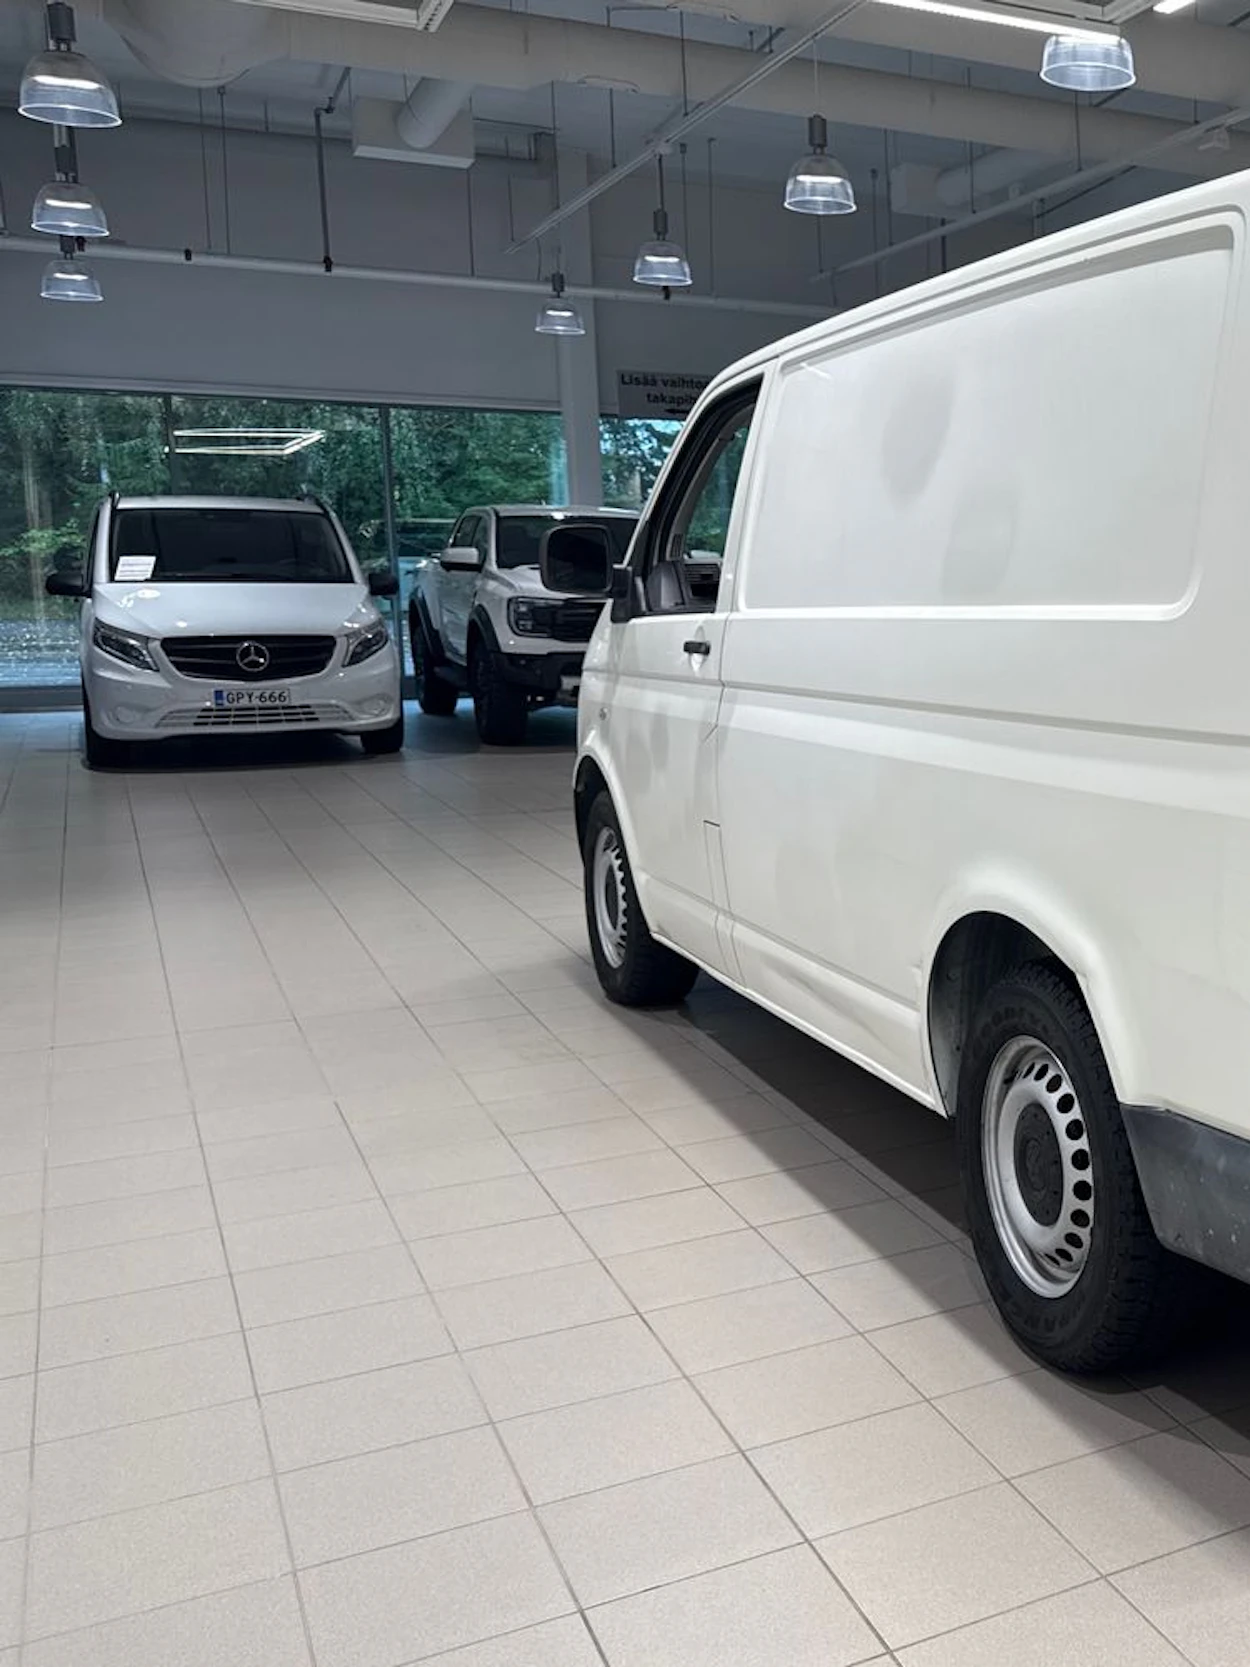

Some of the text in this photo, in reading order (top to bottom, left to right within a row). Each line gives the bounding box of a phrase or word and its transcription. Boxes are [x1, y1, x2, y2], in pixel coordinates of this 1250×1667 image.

[621, 372, 657, 387] Lisää
[646, 391, 698, 407] takapih
[226, 691, 287, 704] GPY-666
